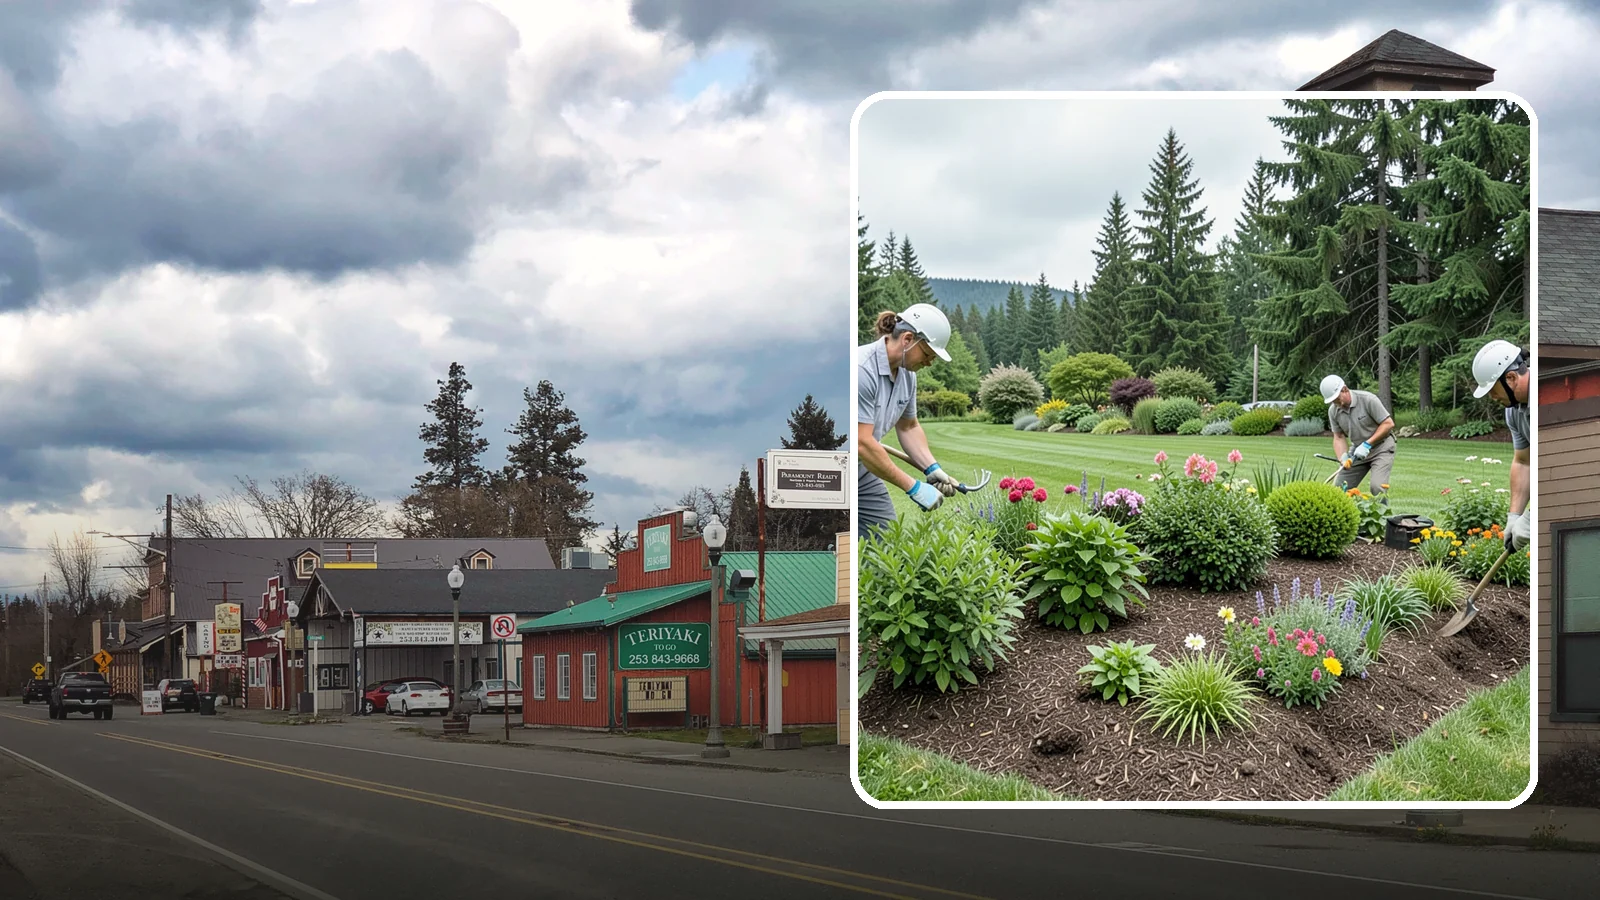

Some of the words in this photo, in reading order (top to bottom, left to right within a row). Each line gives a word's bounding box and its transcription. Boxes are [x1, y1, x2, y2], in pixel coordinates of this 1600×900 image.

[624, 627, 703, 646] TERIYAKI
[629, 655, 649, 665] 253
[651, 654, 700, 664] 843-9668
